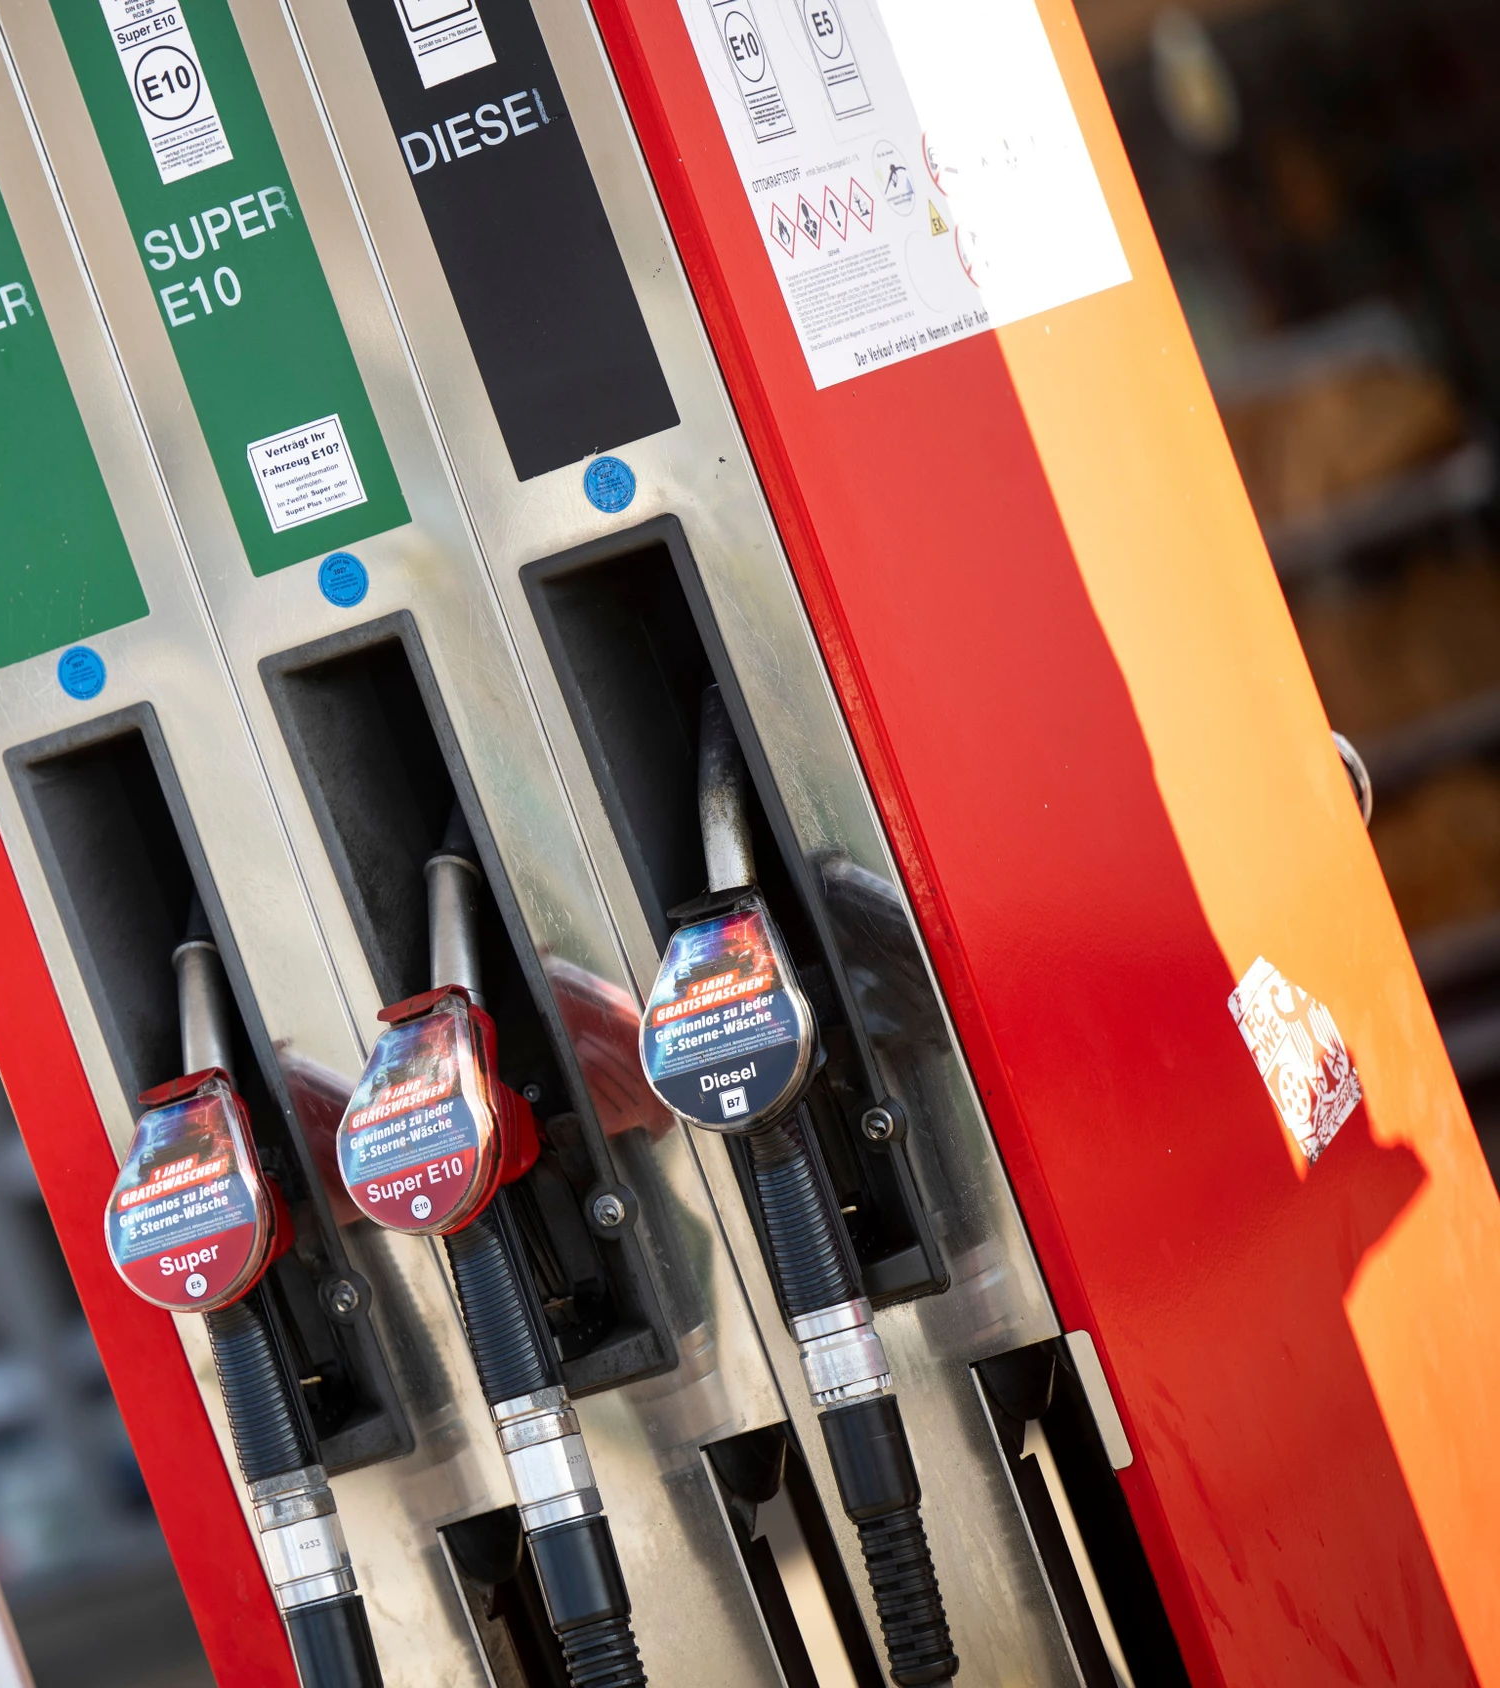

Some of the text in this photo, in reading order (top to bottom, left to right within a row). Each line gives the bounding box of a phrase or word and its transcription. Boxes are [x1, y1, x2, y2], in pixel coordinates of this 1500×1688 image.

[132, 10, 145, 19] ROZ
[811, 10, 834, 37] E5
[117, 14, 176, 45] Super E10
[729, 32, 760, 62] E10
[142, 65, 191, 102] E10
[751, 167, 801, 193] OTTOKRAFTSTOFF
[144, 185, 294, 272] SUPER
[159, 266, 243, 328] E10
[854, 353, 867, 366] Der
[867, 341, 894, 361] Verkauf
[895, 334, 917, 352] erfolgt
[916, 331, 927, 344] im
[926, 325, 950, 340] Namen
[951, 316, 963, 333] und
[962, 314, 973, 328] für
[265, 432, 325, 457] Verträgt Ihr
[262, 443, 339, 477] Fahrzeug E10?
[275, 464, 338, 489] Herstellerinformation
[310, 486, 330, 496] Super
[334, 479, 347, 488] oder
[285, 506, 305, 516] Super
[307, 500, 322, 508] Plus
[333, 567, 347, 576] 2027
[692, 974, 733, 996] 1 JAHR
[655, 995, 773, 1042] Gewinnlos zu jeder
[1244, 1003, 1265, 1040] FC
[665, 1012, 771, 1055] 5-Sterne-Wäsche
[392, 1080, 422, 1098] JAHR
[700, 1062, 756, 1091] Diesel
[726, 1096, 741, 1109] B7
[350, 1102, 453, 1149] Gewinnlos zu jeder
[359, 1119, 451, 1161] 5-Sterne-Wäsche
[154, 1158, 192, 1180] 1 JAHR
[367, 1174, 422, 1202] Super
[427, 1158, 462, 1183] E10
[120, 1179, 230, 1227] Gewinnlos zu jeder
[129, 1196, 228, 1239] 5-Sterne-Wäsche
[414, 1202, 429, 1212] E10
[160, 1245, 218, 1275] Super
[190, 1280, 202, 1290] E5
[299, 1539, 321, 1550] 4233
